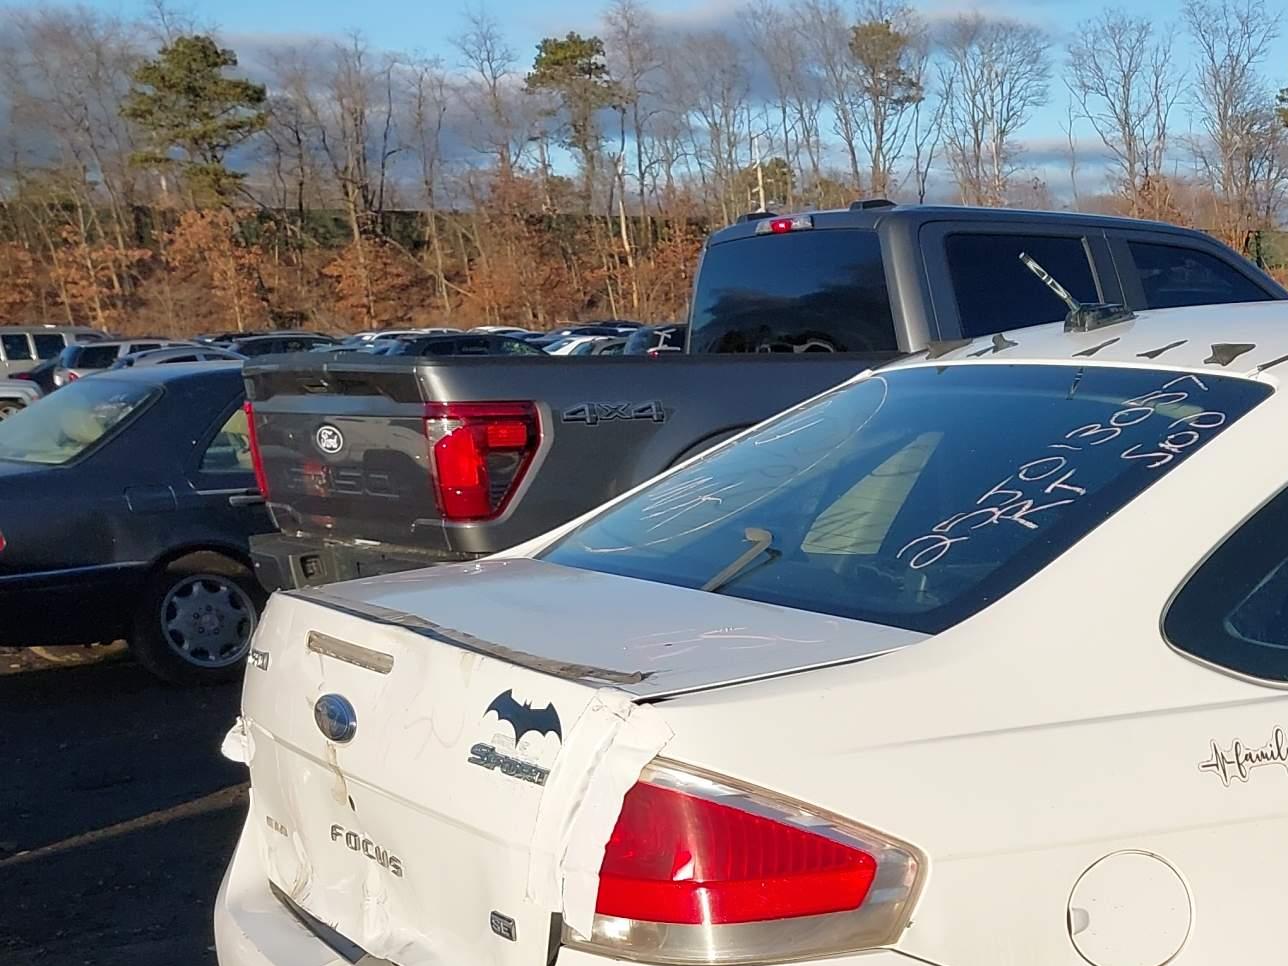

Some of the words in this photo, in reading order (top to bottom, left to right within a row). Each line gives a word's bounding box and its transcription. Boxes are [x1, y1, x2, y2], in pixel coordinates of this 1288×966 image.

[996, 468, 1087, 529] RT
[330, 823, 404, 878] FOCUS
[491, 915, 513, 939] SE
